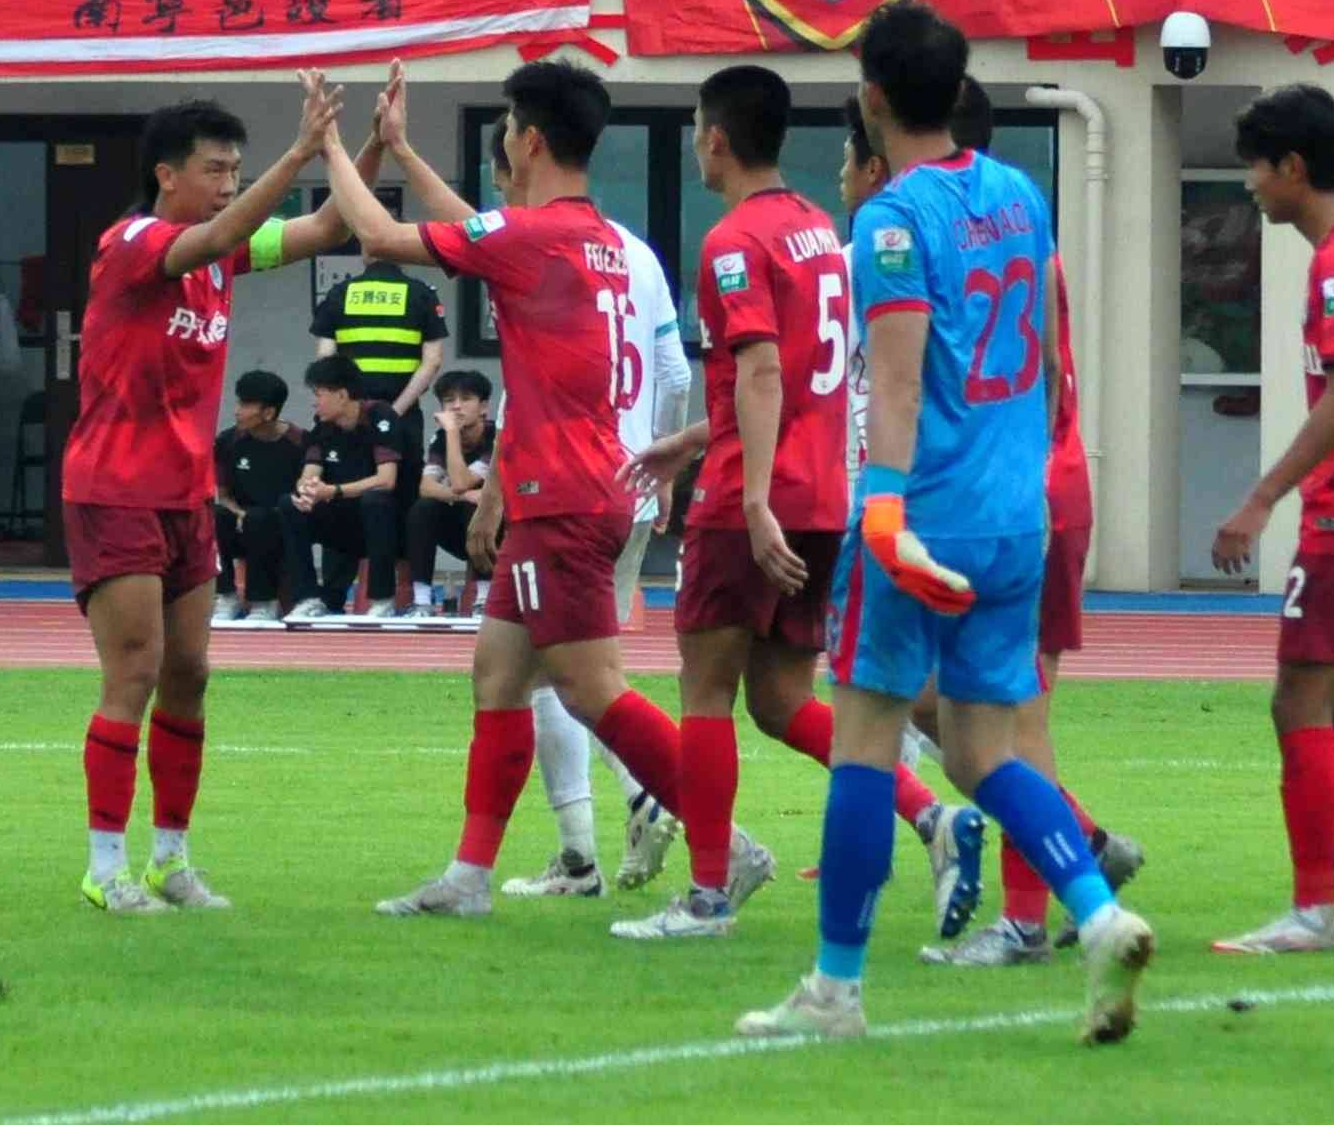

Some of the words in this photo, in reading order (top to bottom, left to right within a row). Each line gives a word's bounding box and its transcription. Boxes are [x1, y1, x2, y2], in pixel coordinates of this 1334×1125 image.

[810, 273, 845, 395] 5
[964, 257, 1042, 404] 23
[510, 560, 540, 612] 11
